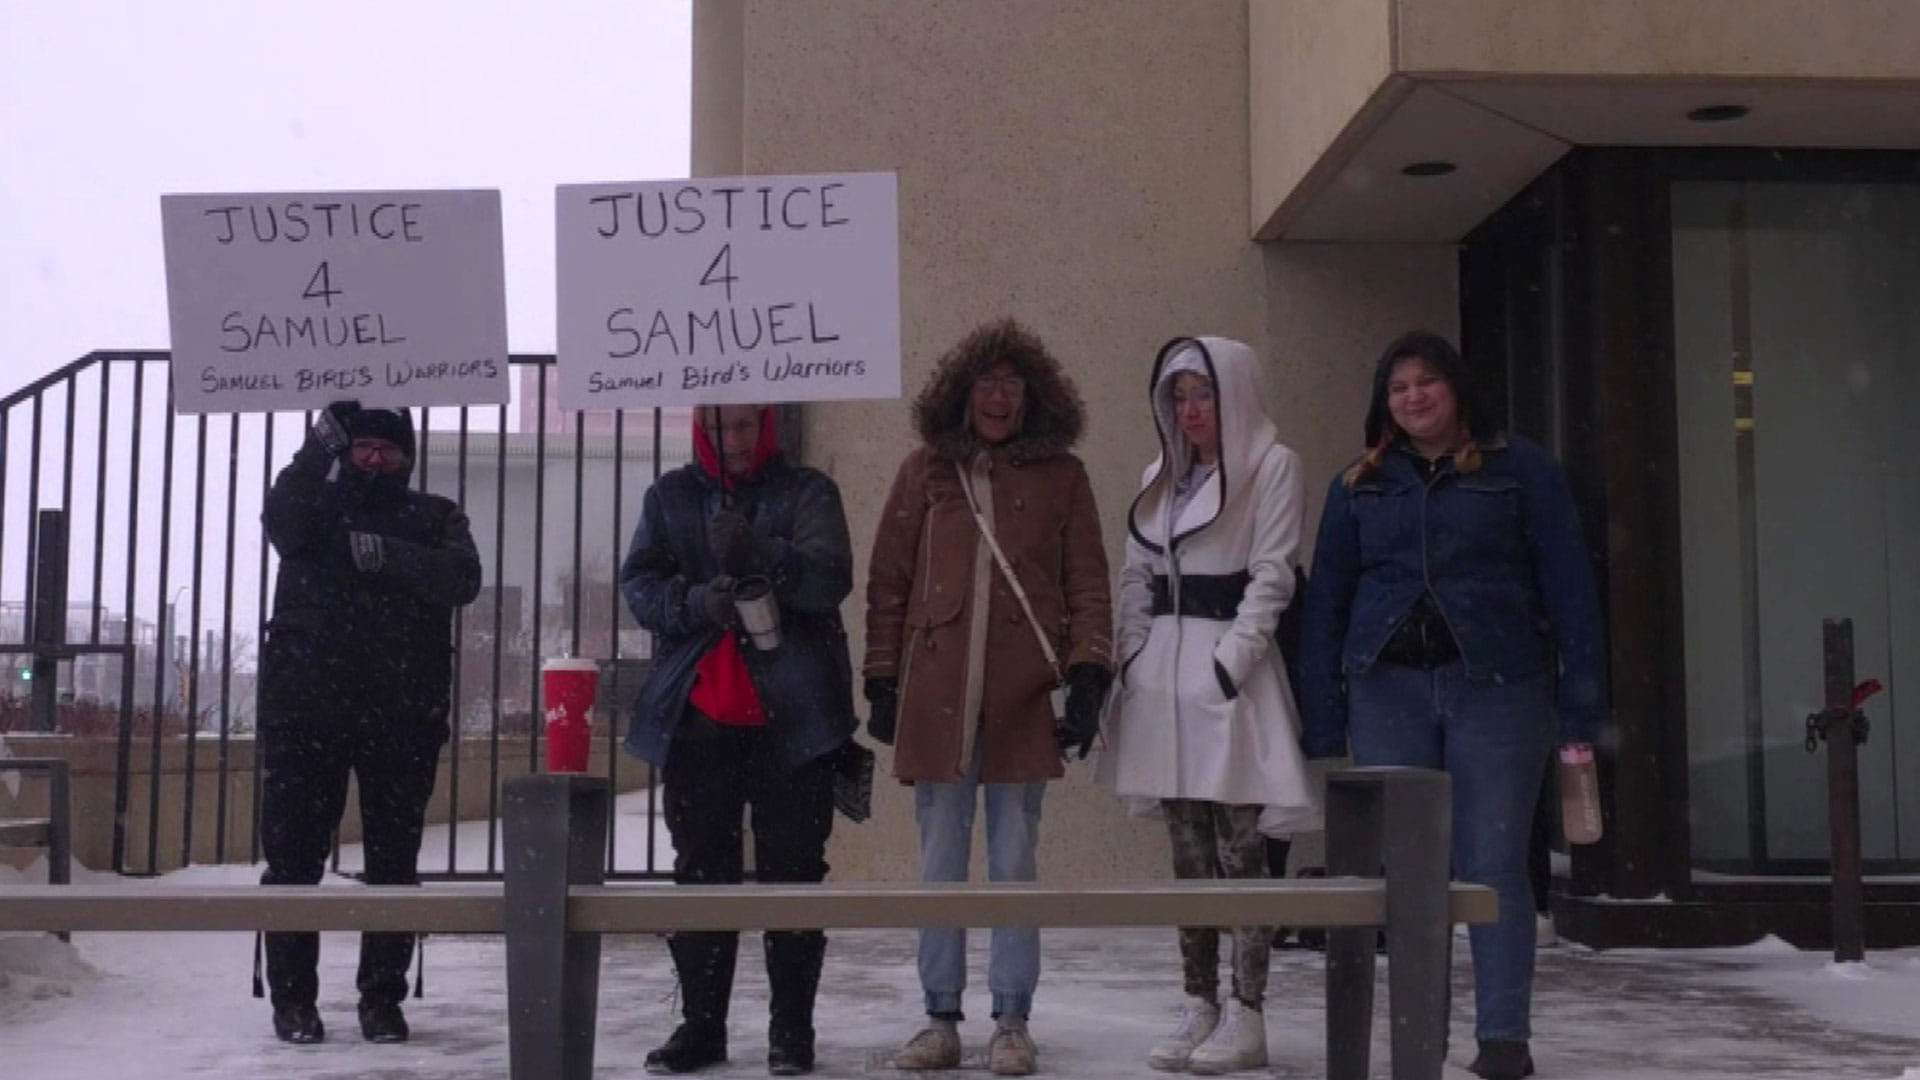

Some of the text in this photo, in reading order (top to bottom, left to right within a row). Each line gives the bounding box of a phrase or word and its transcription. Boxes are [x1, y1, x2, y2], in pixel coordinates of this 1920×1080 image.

[204, 202, 423, 244] JUSTICE
[589, 183, 849, 238] JUSTICE
[302, 260, 343, 308] 4
[699, 242, 740, 302] 4
[220, 310, 406, 352] SAMUEL
[606, 301, 840, 358] SAMUEL
[200, 366, 284, 393] SAMUEL
[385, 358, 498, 388] WARRIORS
[588, 351, 866, 393] Samuel Bird's Warriors
